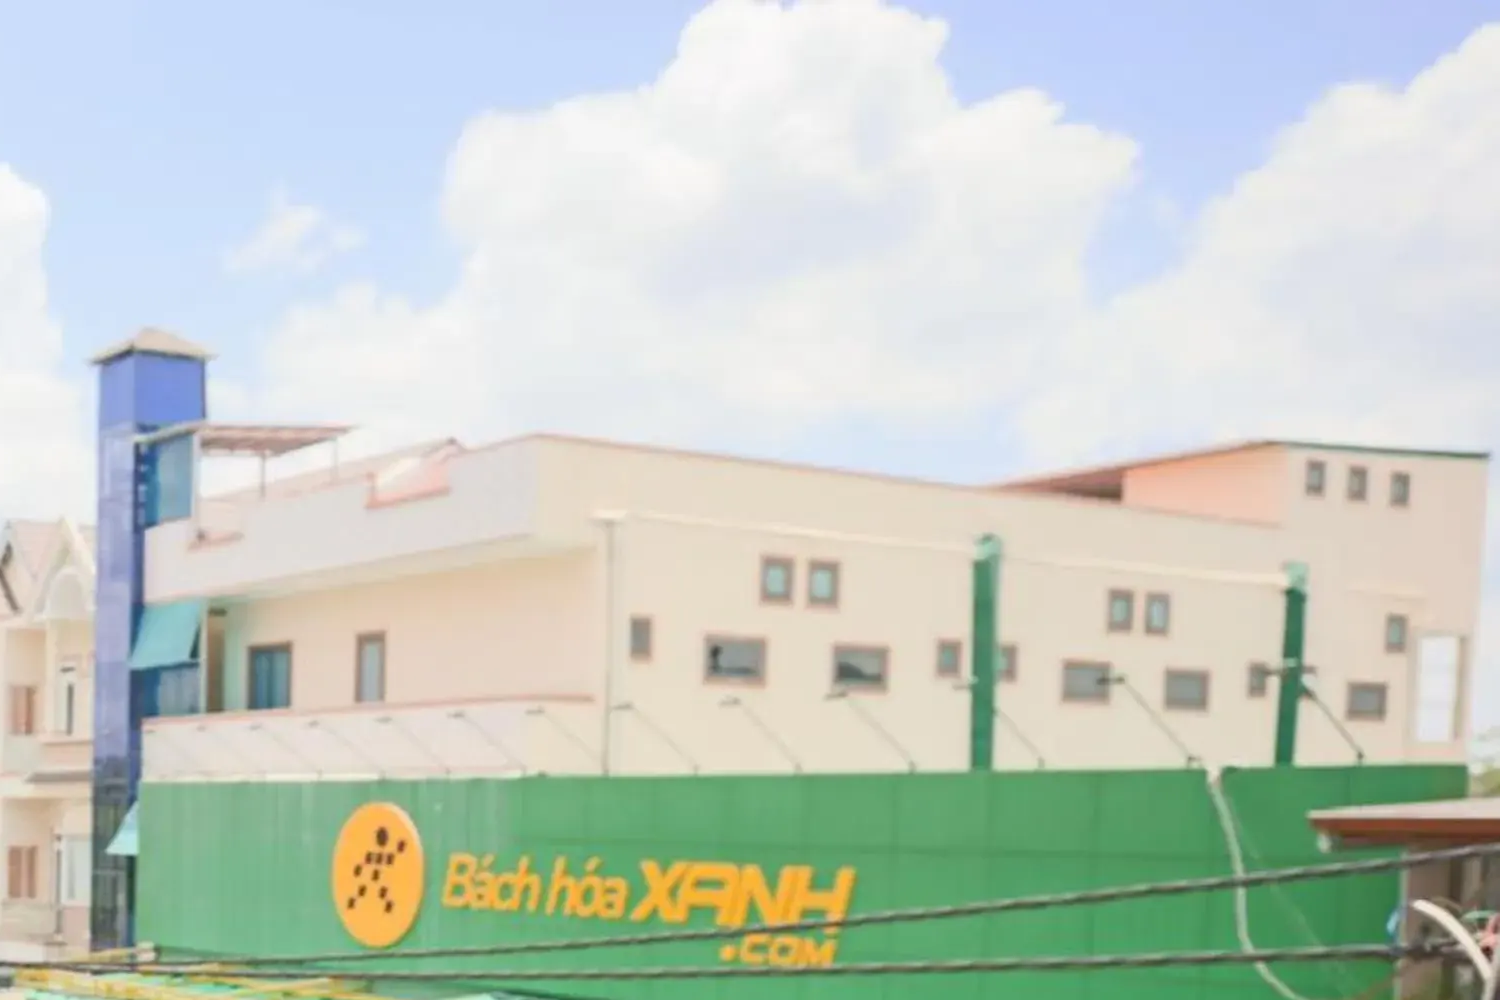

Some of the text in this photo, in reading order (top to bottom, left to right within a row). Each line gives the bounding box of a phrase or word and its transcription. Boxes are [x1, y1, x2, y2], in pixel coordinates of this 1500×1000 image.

[442, 852, 856, 934] Bách hóa XANH
[719, 932, 836, 969] .COM
